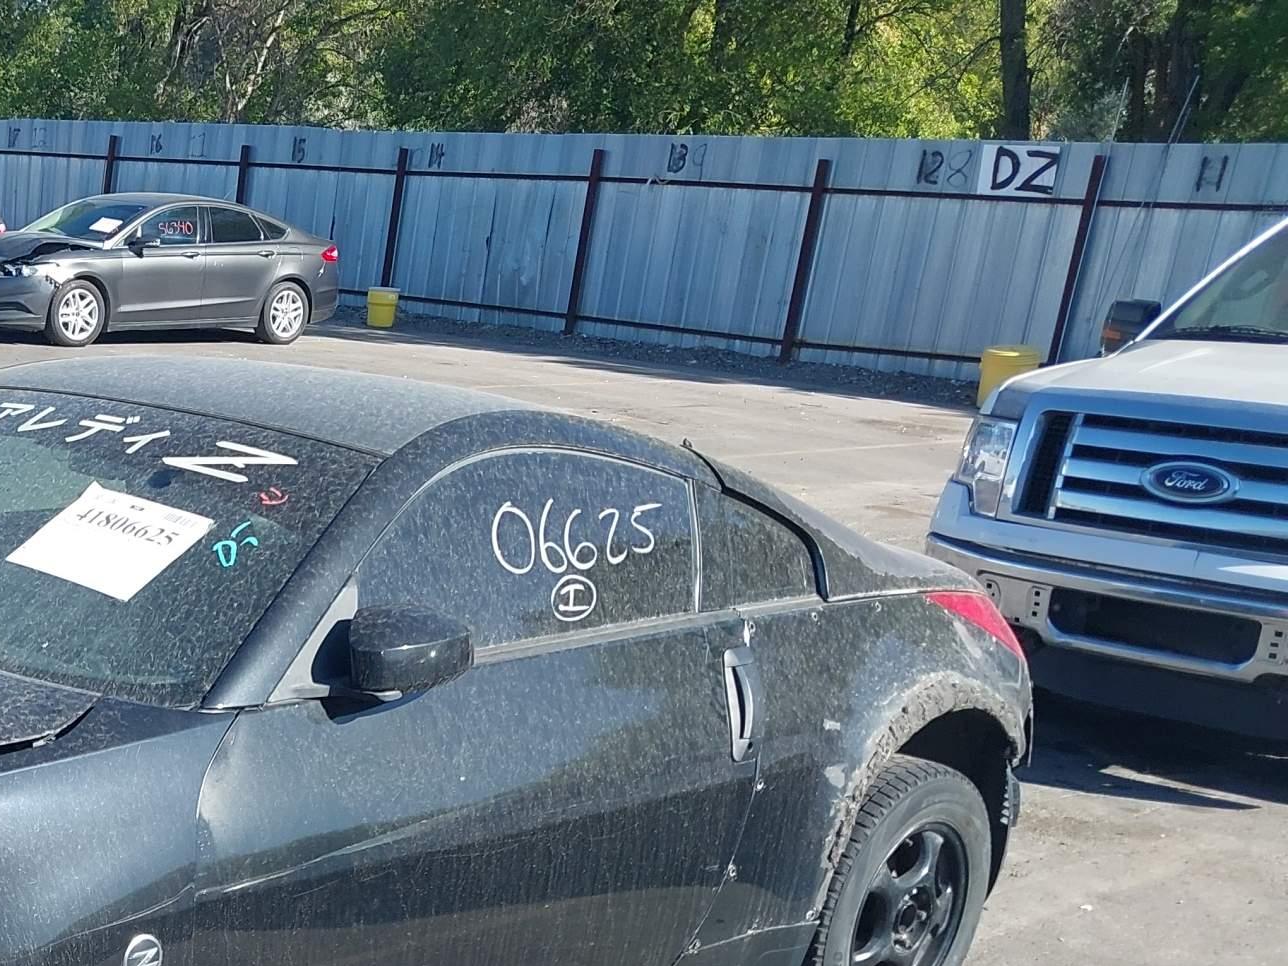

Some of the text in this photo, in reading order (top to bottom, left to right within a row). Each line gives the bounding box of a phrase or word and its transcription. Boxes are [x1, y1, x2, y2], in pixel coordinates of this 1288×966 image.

[291, 136, 308, 164] 15
[990, 145, 1057, 195] DZ
[1164, 471, 1209, 491] Ford
[75, 507, 181, 547] 41806625
[491, 498, 663, 575] 06625
